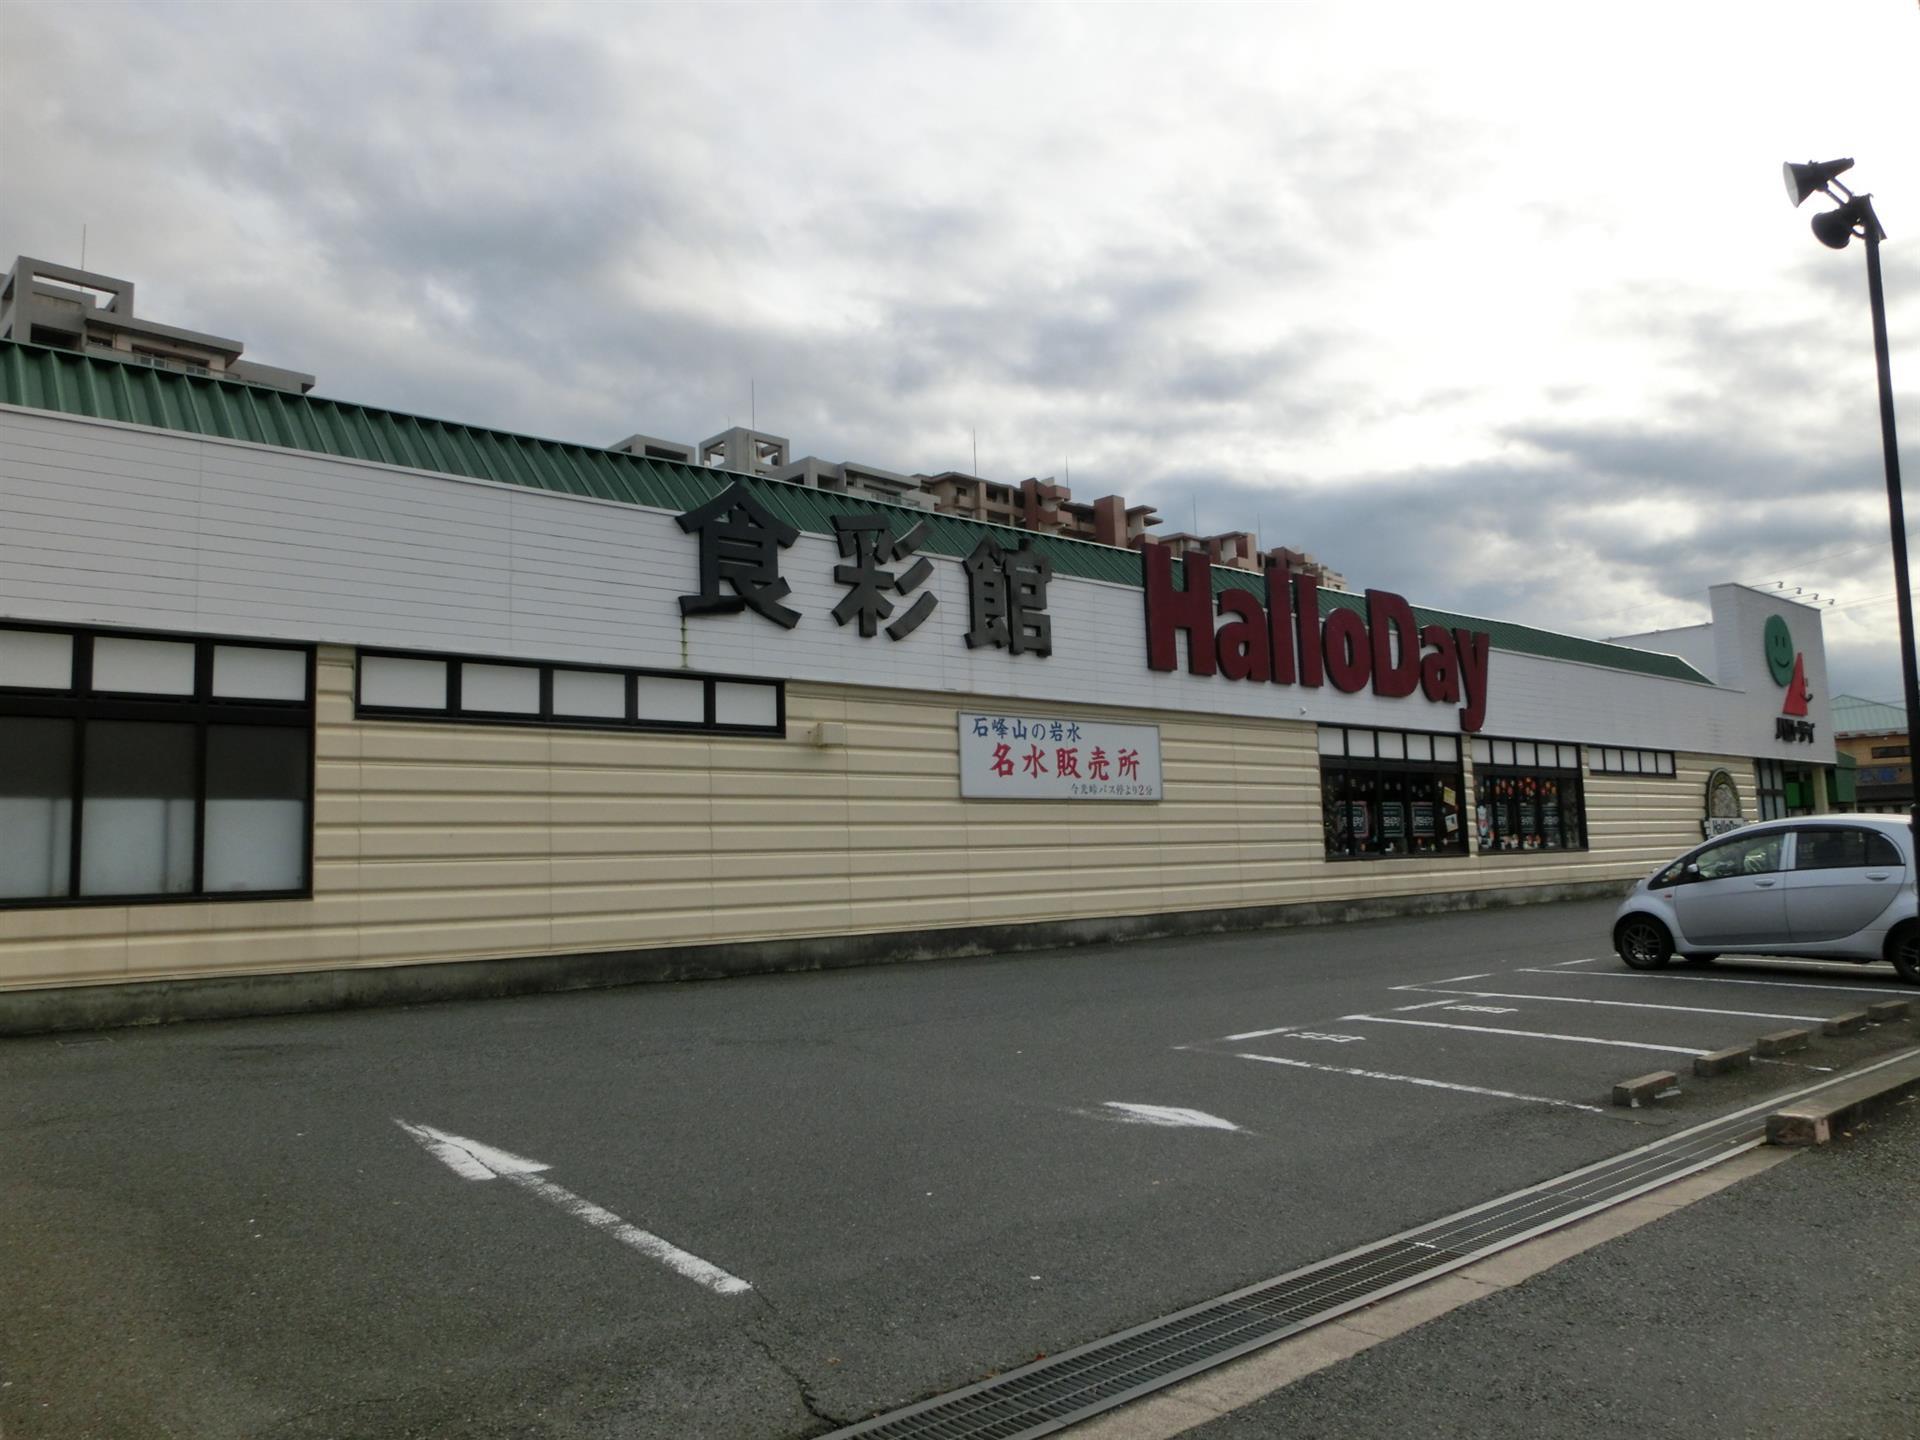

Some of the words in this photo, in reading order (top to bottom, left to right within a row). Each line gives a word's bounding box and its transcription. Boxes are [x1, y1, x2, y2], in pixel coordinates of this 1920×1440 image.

[675, 480, 1053, 657] 食彩館
[1142, 543, 1490, 732] HalloDay
[973, 717, 1082, 743] 石峰山の岩水
[990, 743, 1140, 781] 名水販売所
